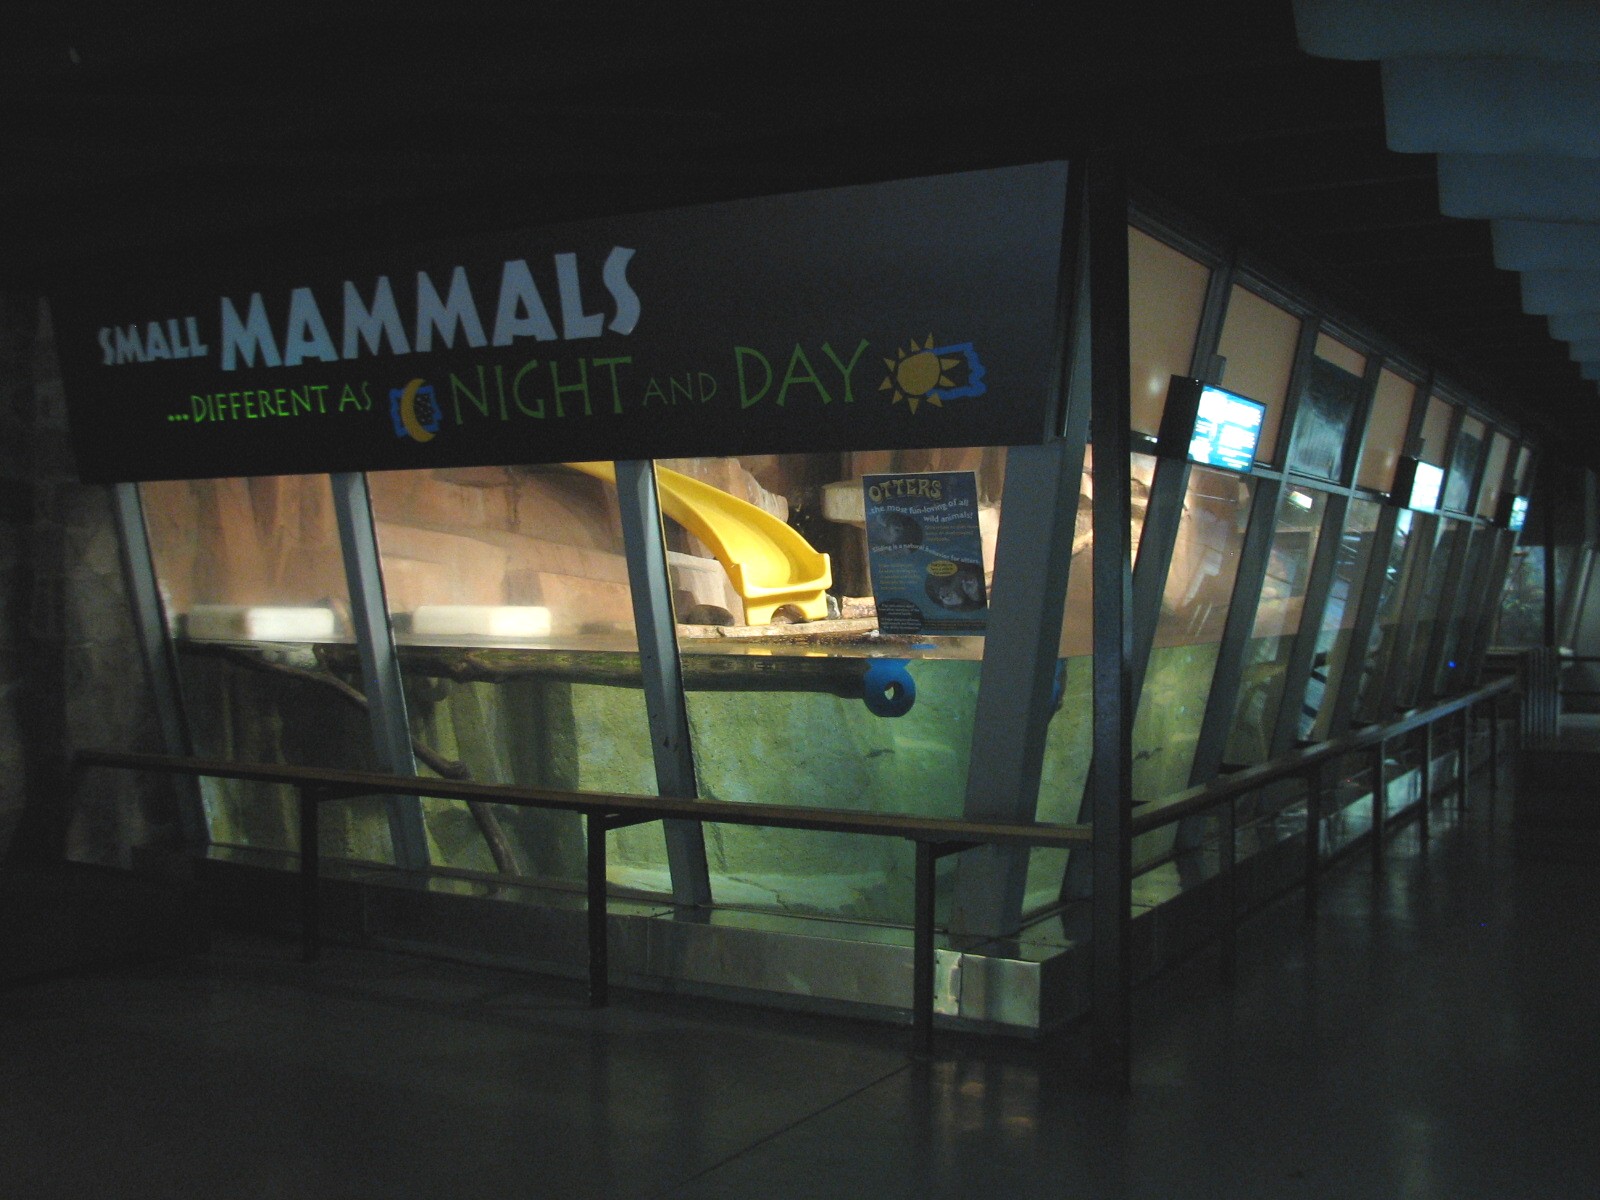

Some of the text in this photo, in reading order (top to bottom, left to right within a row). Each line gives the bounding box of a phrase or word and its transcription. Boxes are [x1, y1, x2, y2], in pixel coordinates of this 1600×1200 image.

[97, 245, 642, 371] SMALL MAMMALS
[338, 380, 373, 412] AS
[449, 355, 633, 426] NIGHT
[642, 372, 717, 406] AND
[734, 338, 870, 409] DAY
[868, 478, 942, 503] OTTERS
[909, 503, 948, 514] fun-loving
[948, 498, 957, 507] of
[923, 515, 939, 523] wild
